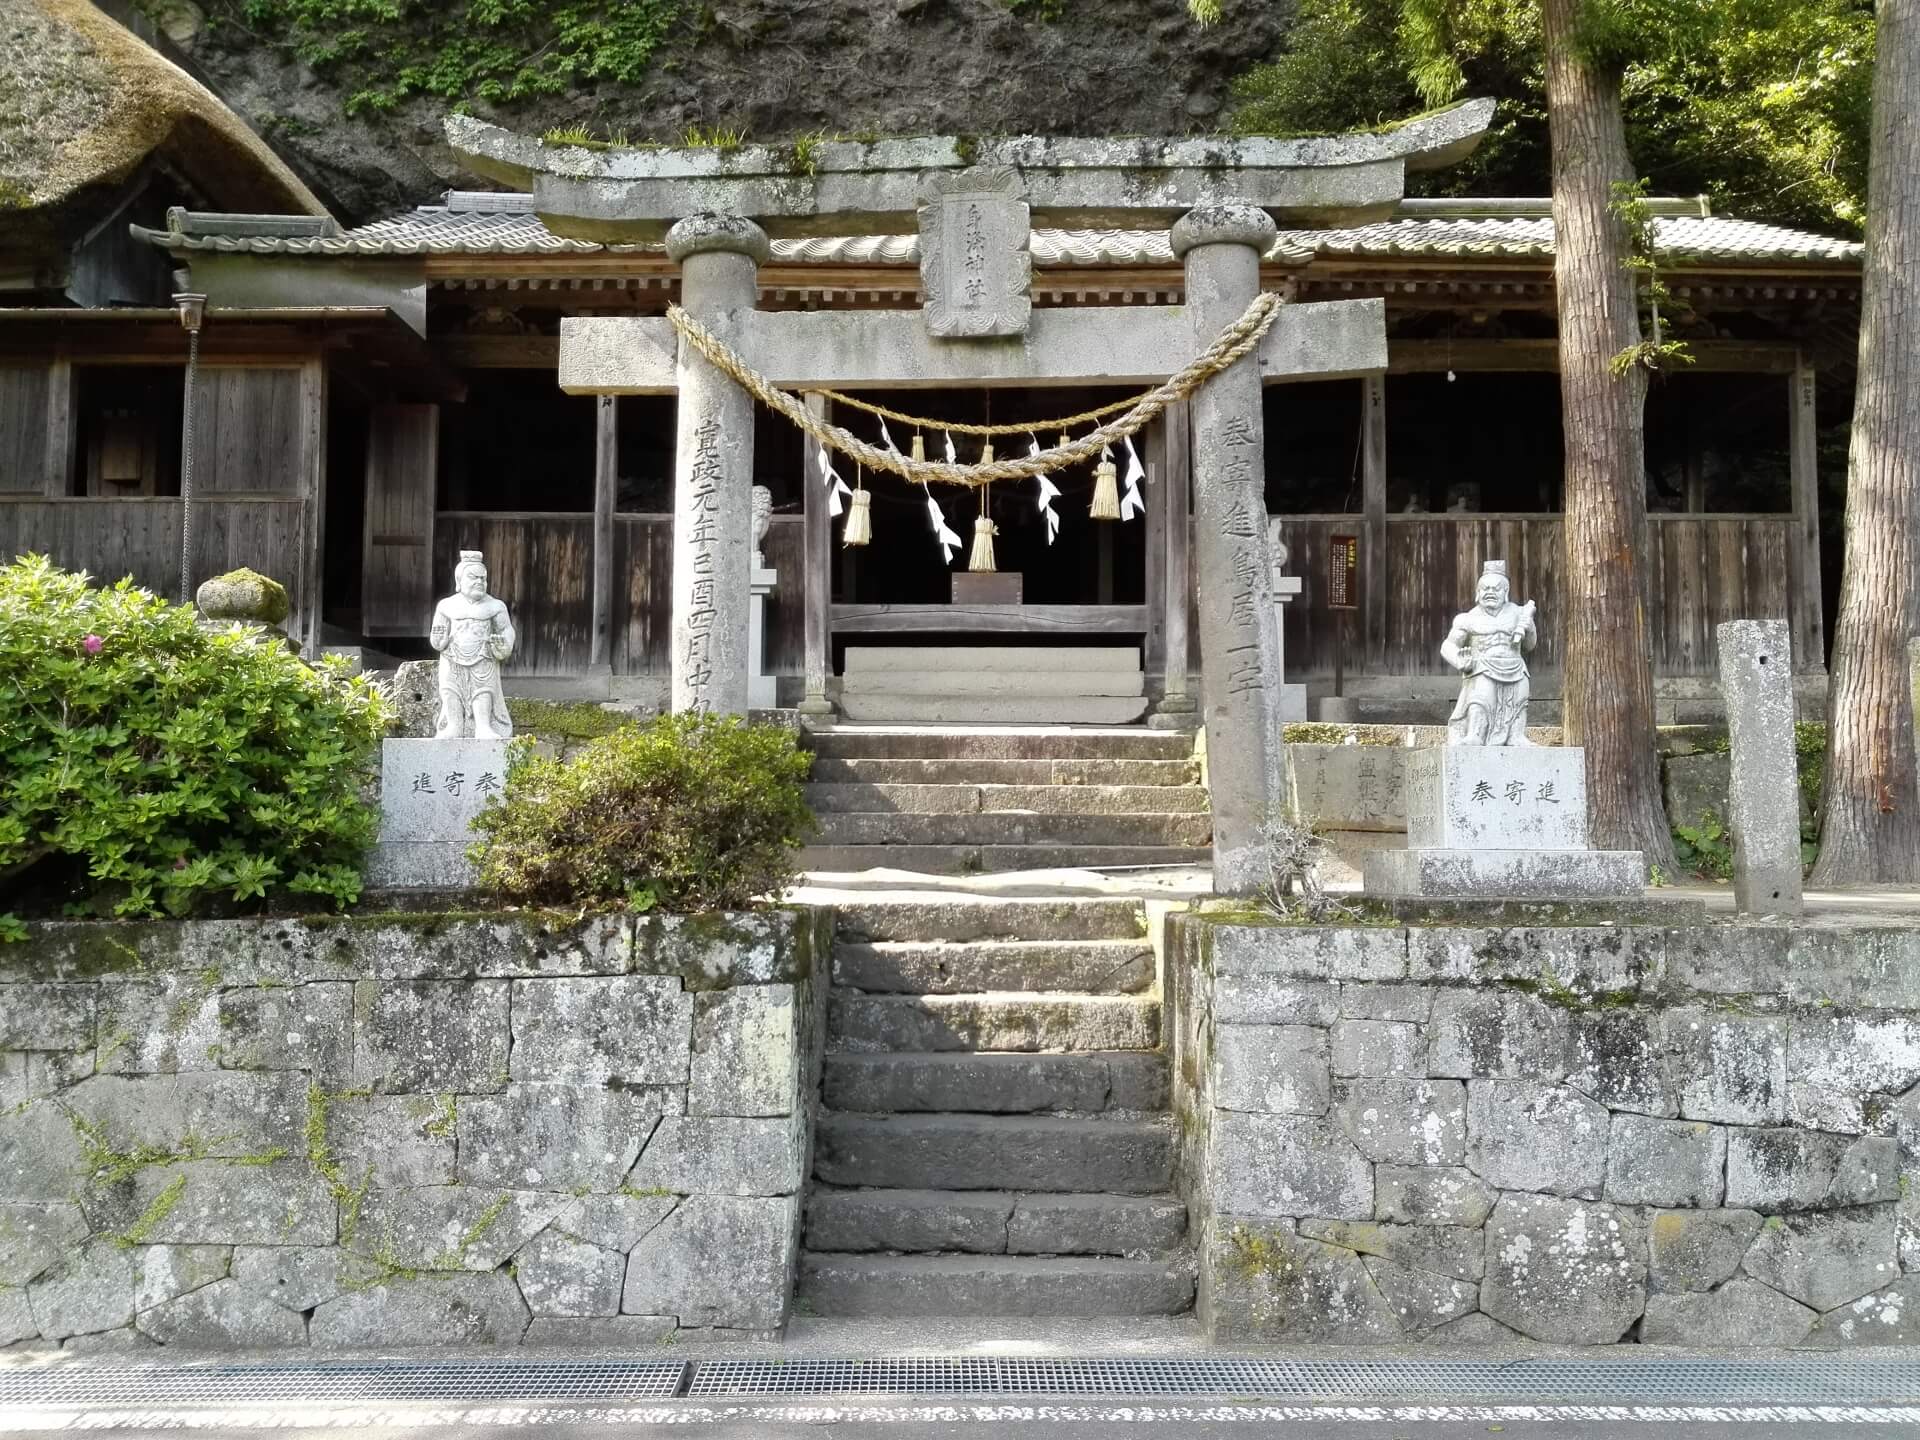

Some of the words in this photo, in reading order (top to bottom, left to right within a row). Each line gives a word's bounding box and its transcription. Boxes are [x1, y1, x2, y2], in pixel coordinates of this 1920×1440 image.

[1221, 416, 1263, 702] 奉寄進鳥居一宇
[1470, 779, 1561, 808] 奉寄進
